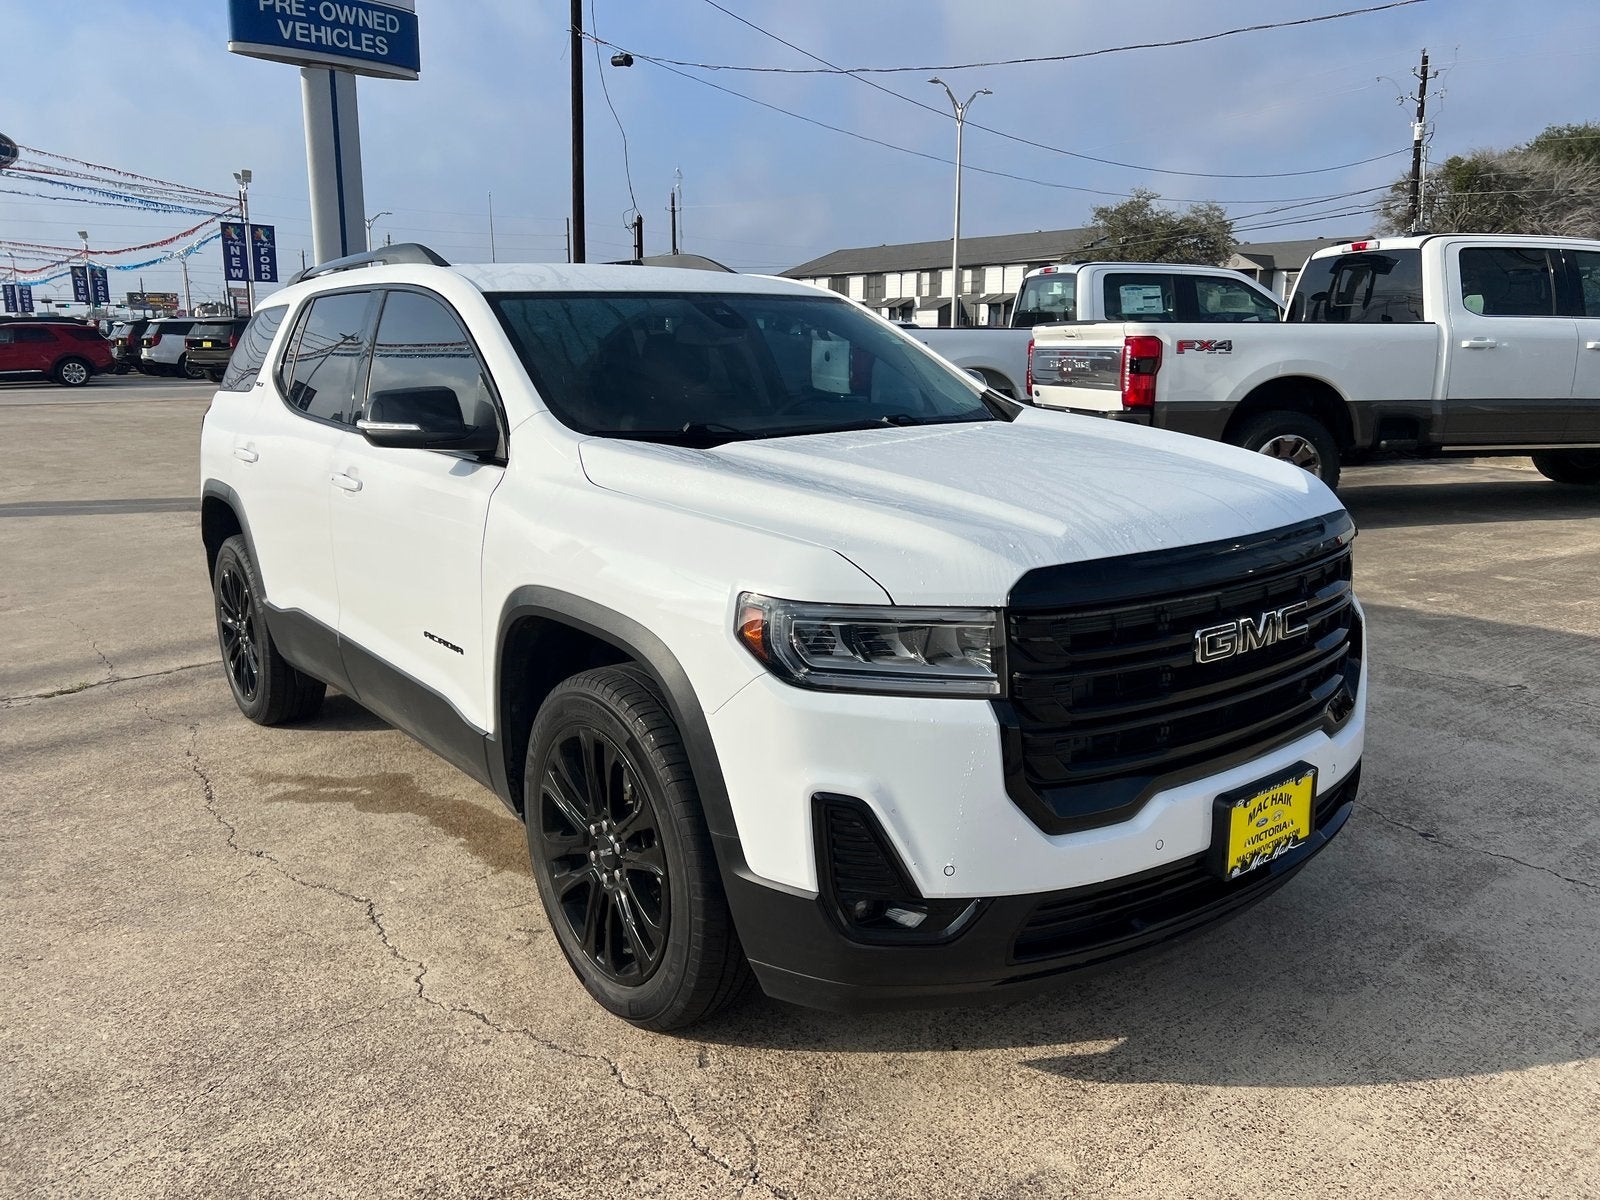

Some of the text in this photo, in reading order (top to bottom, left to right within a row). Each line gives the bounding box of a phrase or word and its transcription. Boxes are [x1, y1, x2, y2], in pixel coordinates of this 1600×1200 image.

[259, 0, 400, 34] PRE-OWNED
[277, 19, 389, 56] VEHICLES
[230, 245, 244, 279] NEW
[260, 247, 272, 280] FORD
[77, 280, 87, 301] NEW
[1176, 339, 1233, 355] FX4
[423, 630, 465, 656] ACADIA
[1194, 600, 1309, 664] GMC
[1248, 797, 1270, 826] MAC
[1270, 792, 1293, 807] HAIK
[1250, 822, 1288, 845] VICTORIA
